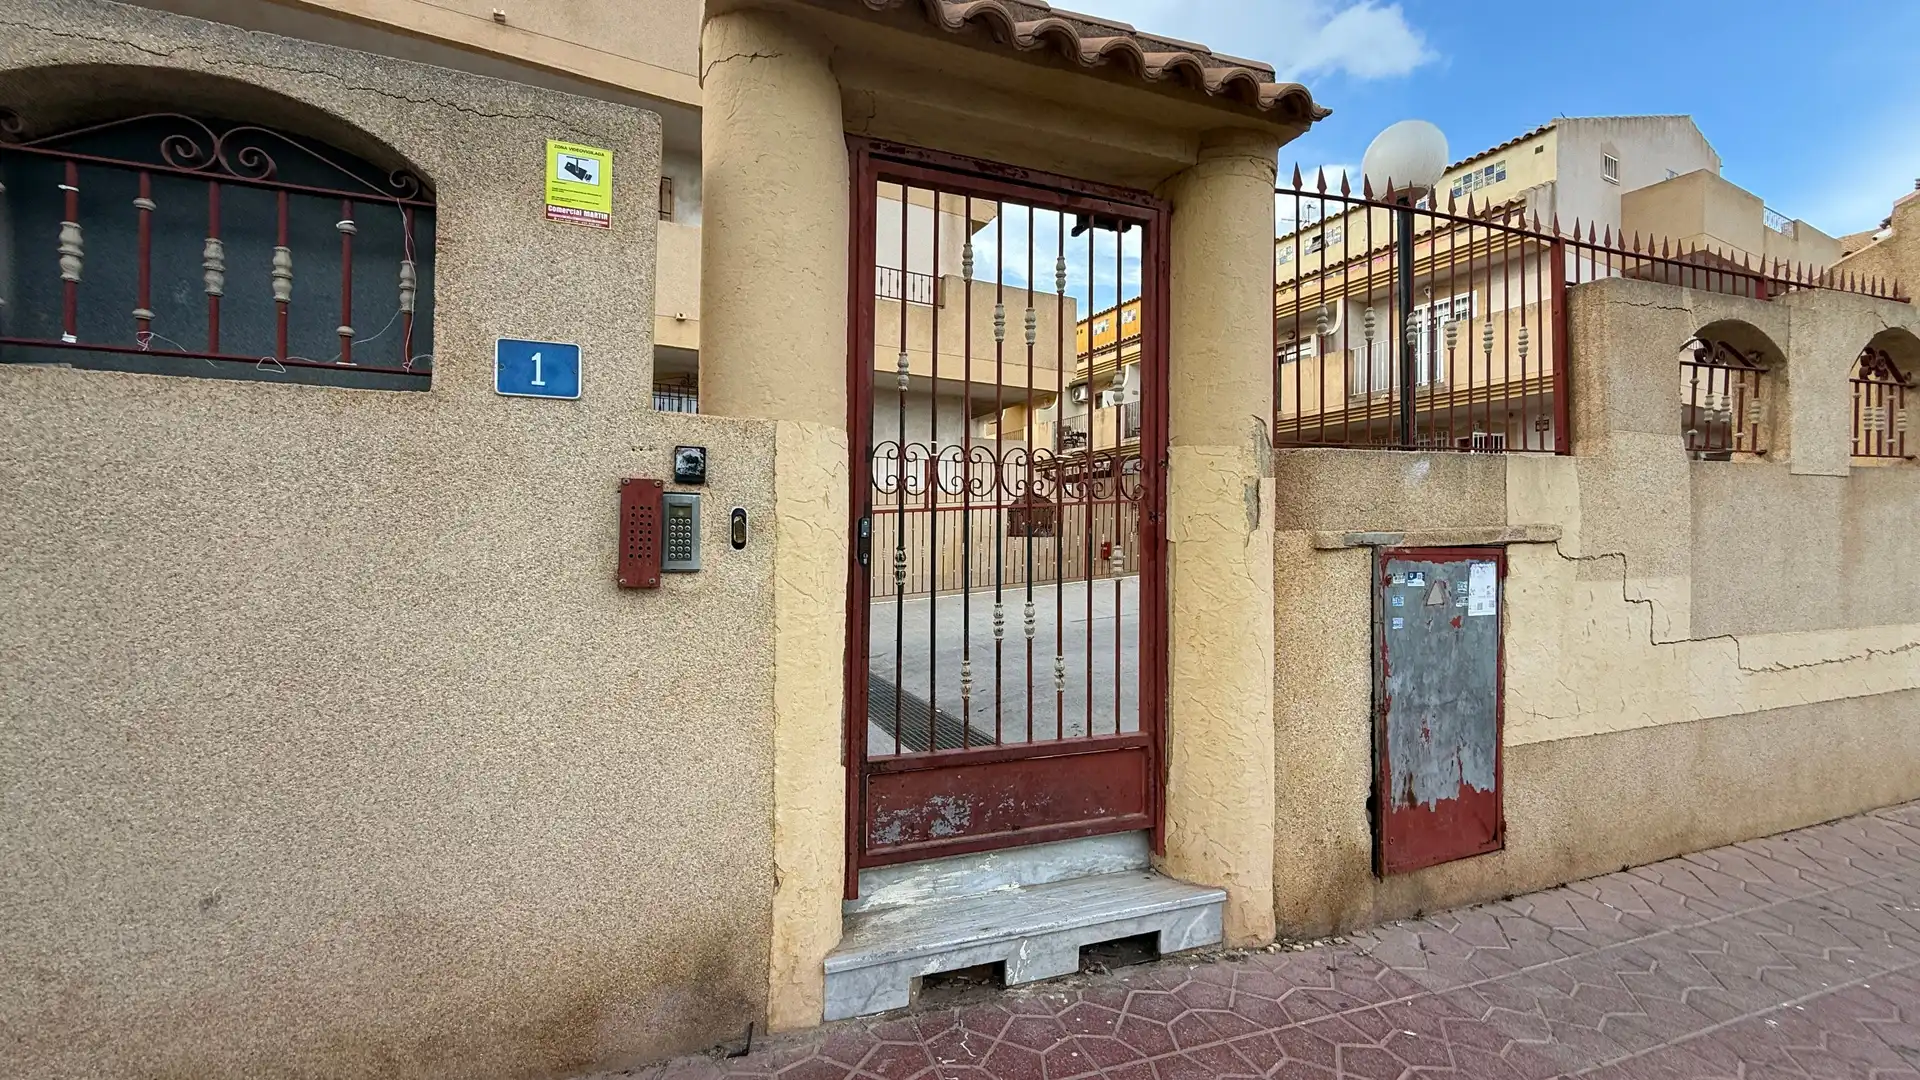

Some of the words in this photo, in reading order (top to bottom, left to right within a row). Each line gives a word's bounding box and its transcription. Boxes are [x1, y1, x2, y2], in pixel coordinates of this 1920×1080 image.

[568, 147, 605, 157] VIDEOVIGILADA
[548, 205, 582, 216] Comercial
[531, 352, 546, 386] 1
